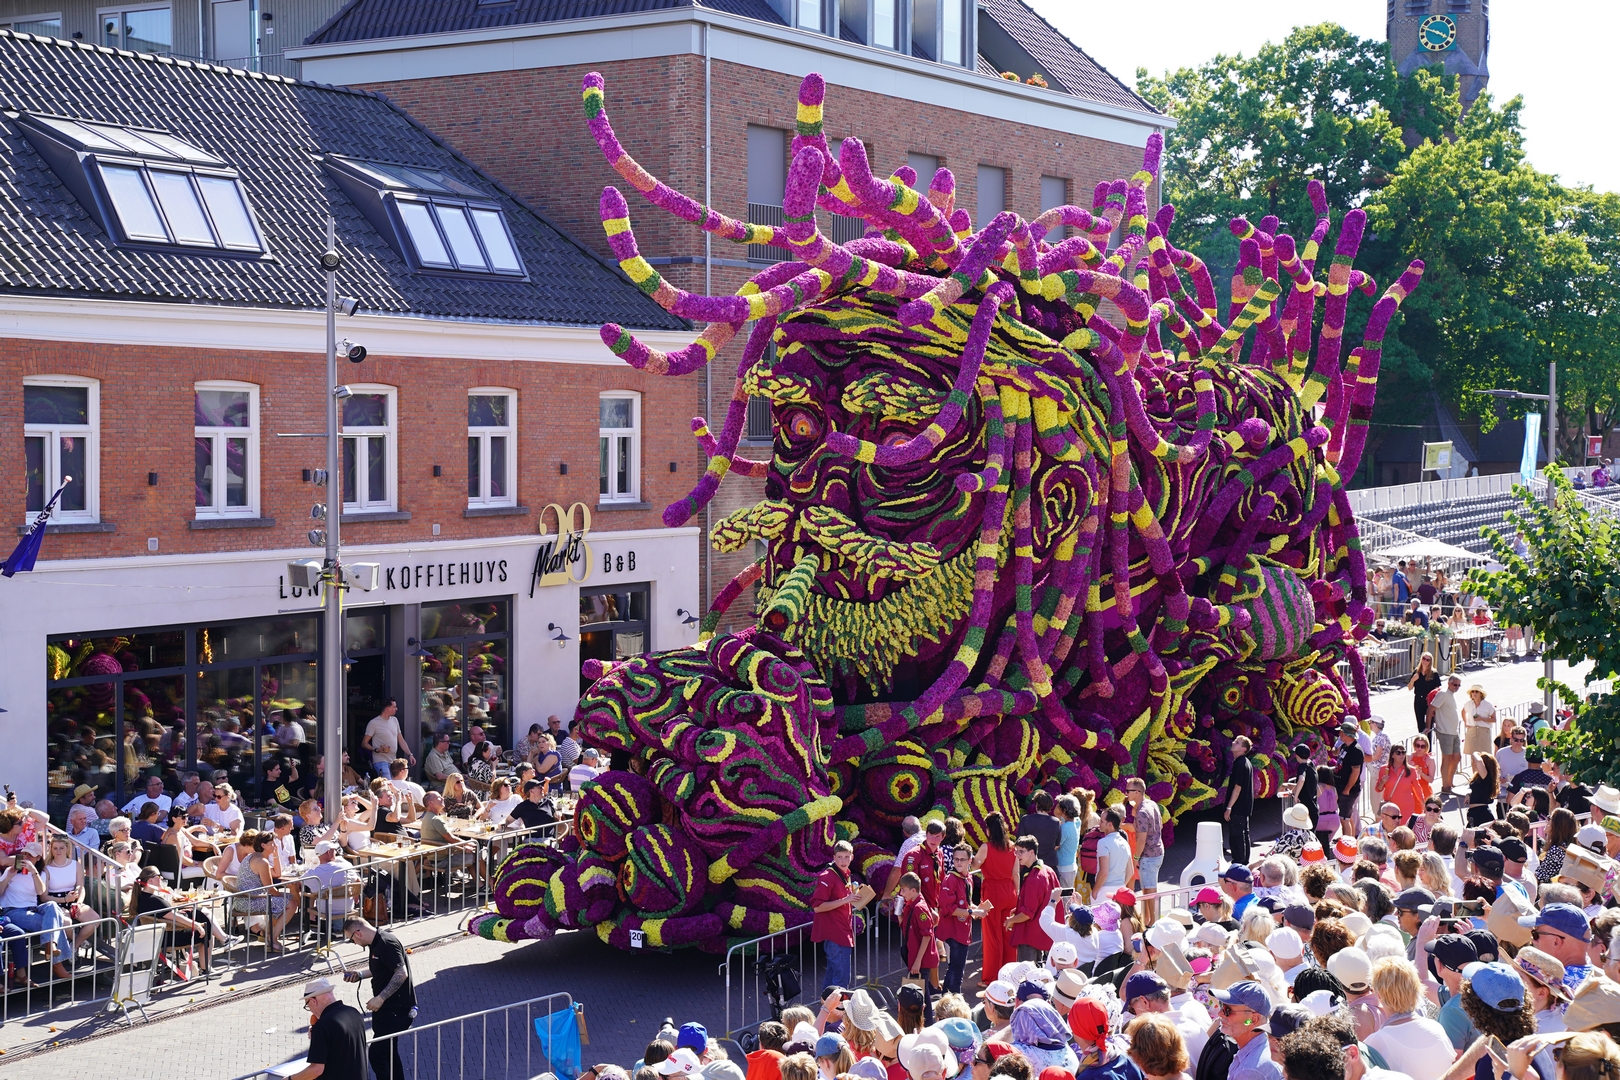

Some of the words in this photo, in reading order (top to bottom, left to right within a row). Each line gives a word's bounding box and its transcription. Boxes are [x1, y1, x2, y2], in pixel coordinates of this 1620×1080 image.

[528, 533, 581, 598] Markt
[539, 502, 594, 587] 28
[386, 560, 508, 590] KOFFIEHUYS
[632, 932, 642, 941] 20
